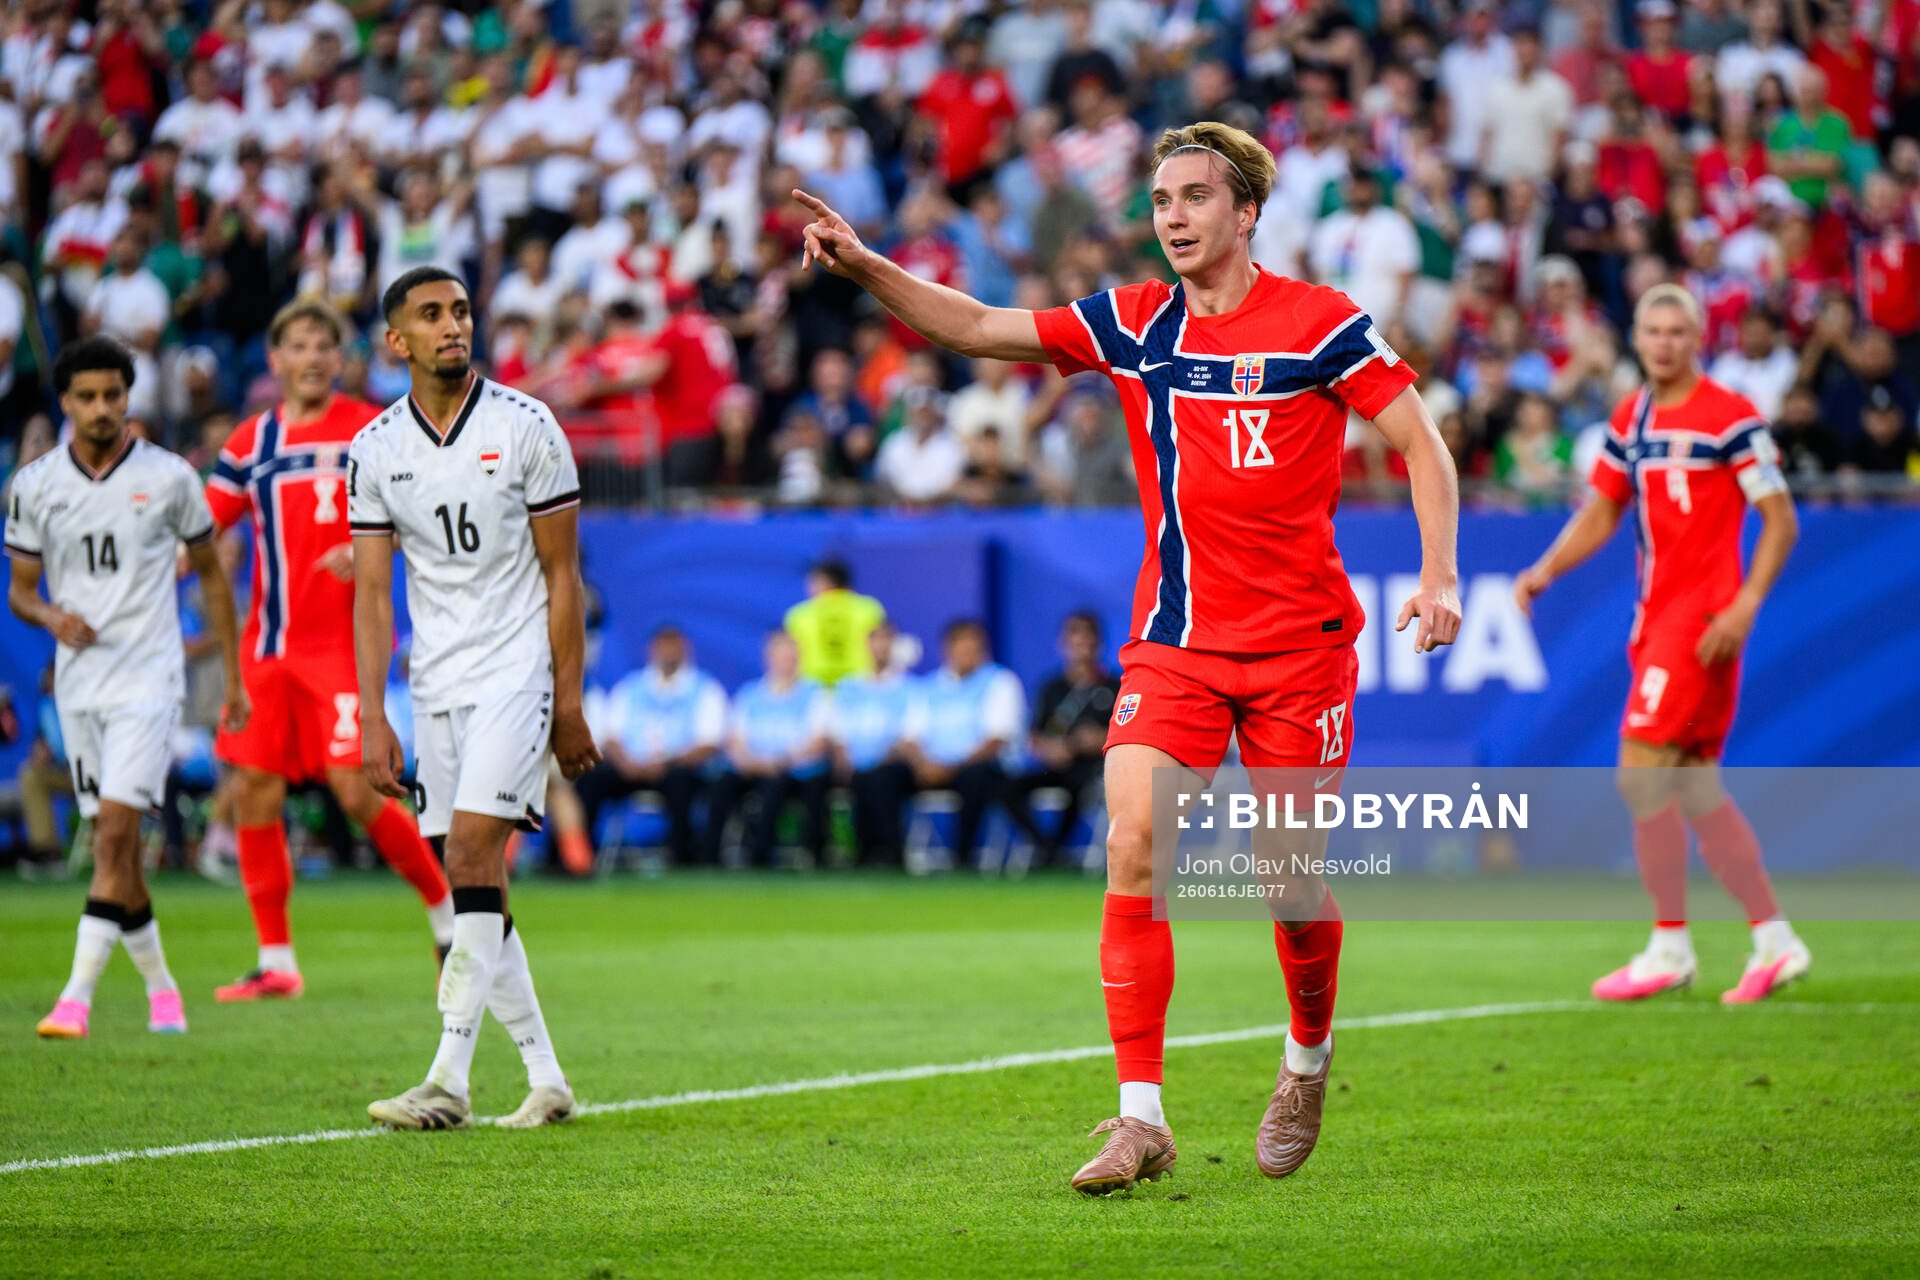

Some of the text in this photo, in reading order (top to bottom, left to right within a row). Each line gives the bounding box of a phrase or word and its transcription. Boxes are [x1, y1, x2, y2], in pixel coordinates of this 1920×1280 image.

[1222, 409, 1275, 468] 18
[82, 533, 118, 573] 14
[435, 502, 480, 555] 16
[1347, 572, 1548, 694] IFA
[1639, 664, 1669, 715] 9
[1316, 700, 1347, 765] 18
